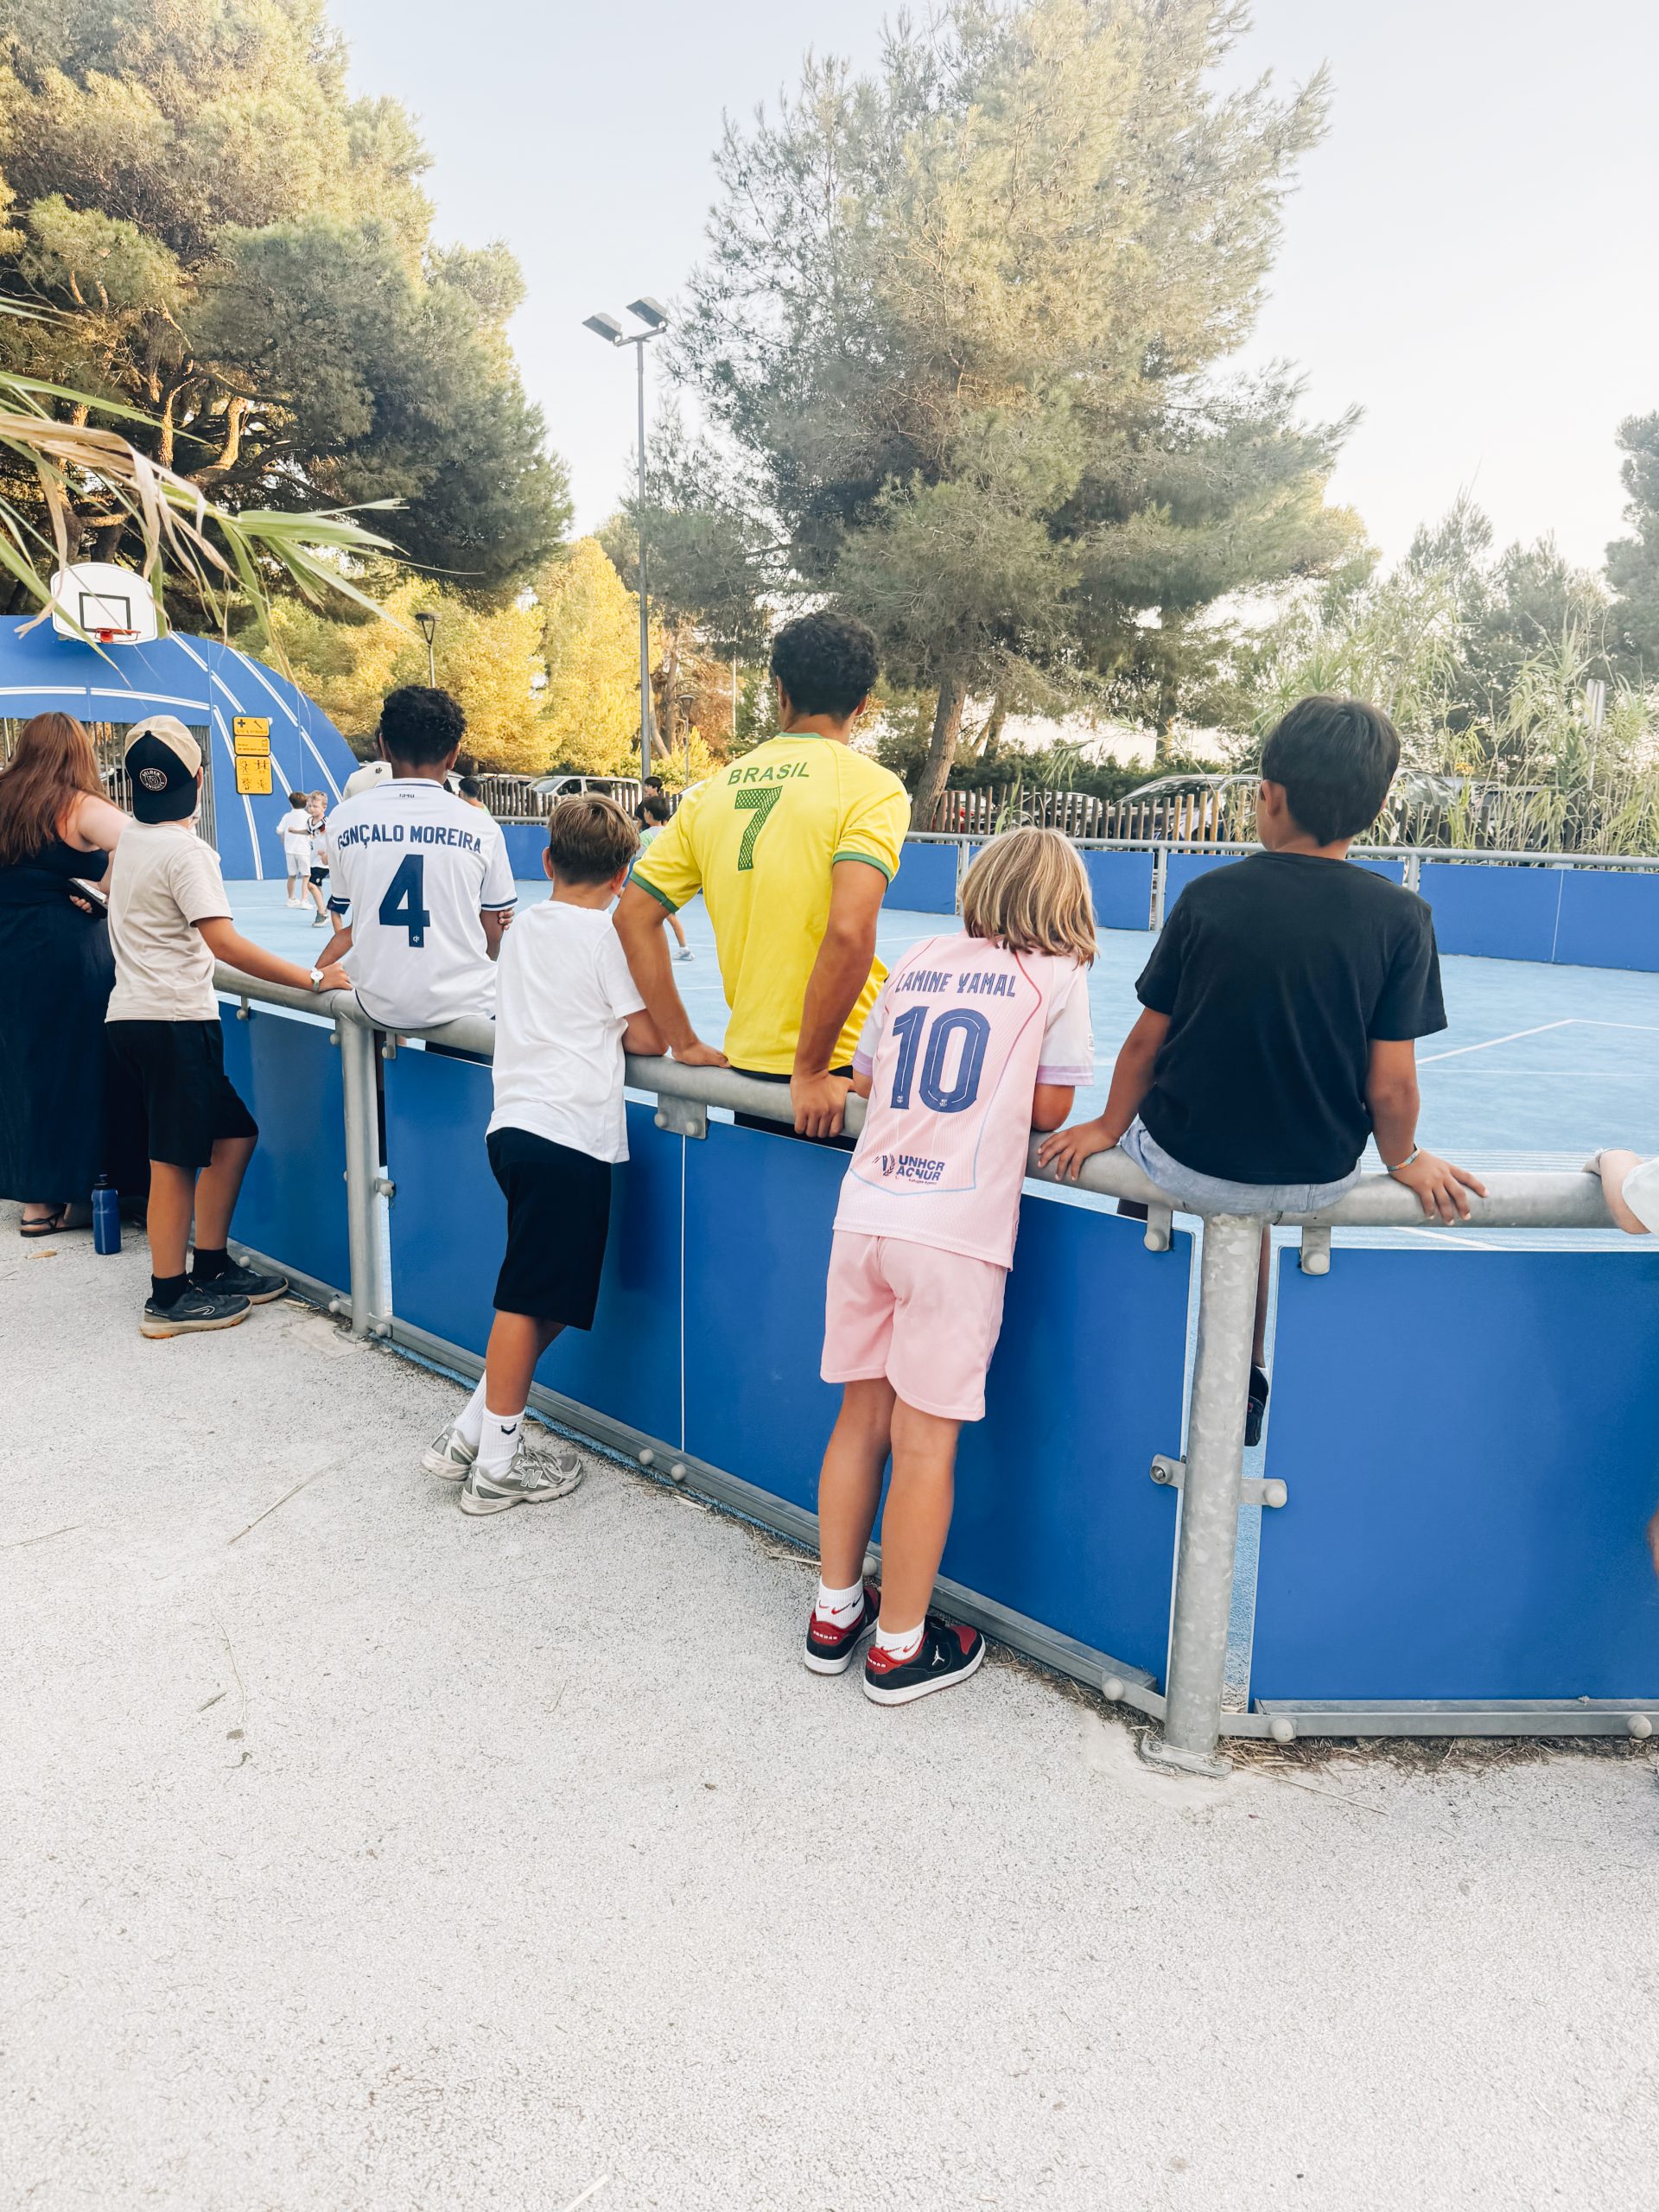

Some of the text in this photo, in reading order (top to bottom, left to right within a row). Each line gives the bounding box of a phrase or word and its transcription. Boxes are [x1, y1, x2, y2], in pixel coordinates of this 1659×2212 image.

[728, 762, 810, 785] BRASIL
[338, 824, 481, 854] GONÇALO MOREIRA
[734, 785, 783, 871] 7
[378, 854, 431, 948] 4
[895, 969, 1016, 997] LAMINE YAMAL
[890, 1006, 991, 1113] 10
[899, 1154, 945, 1172] UNHCR
